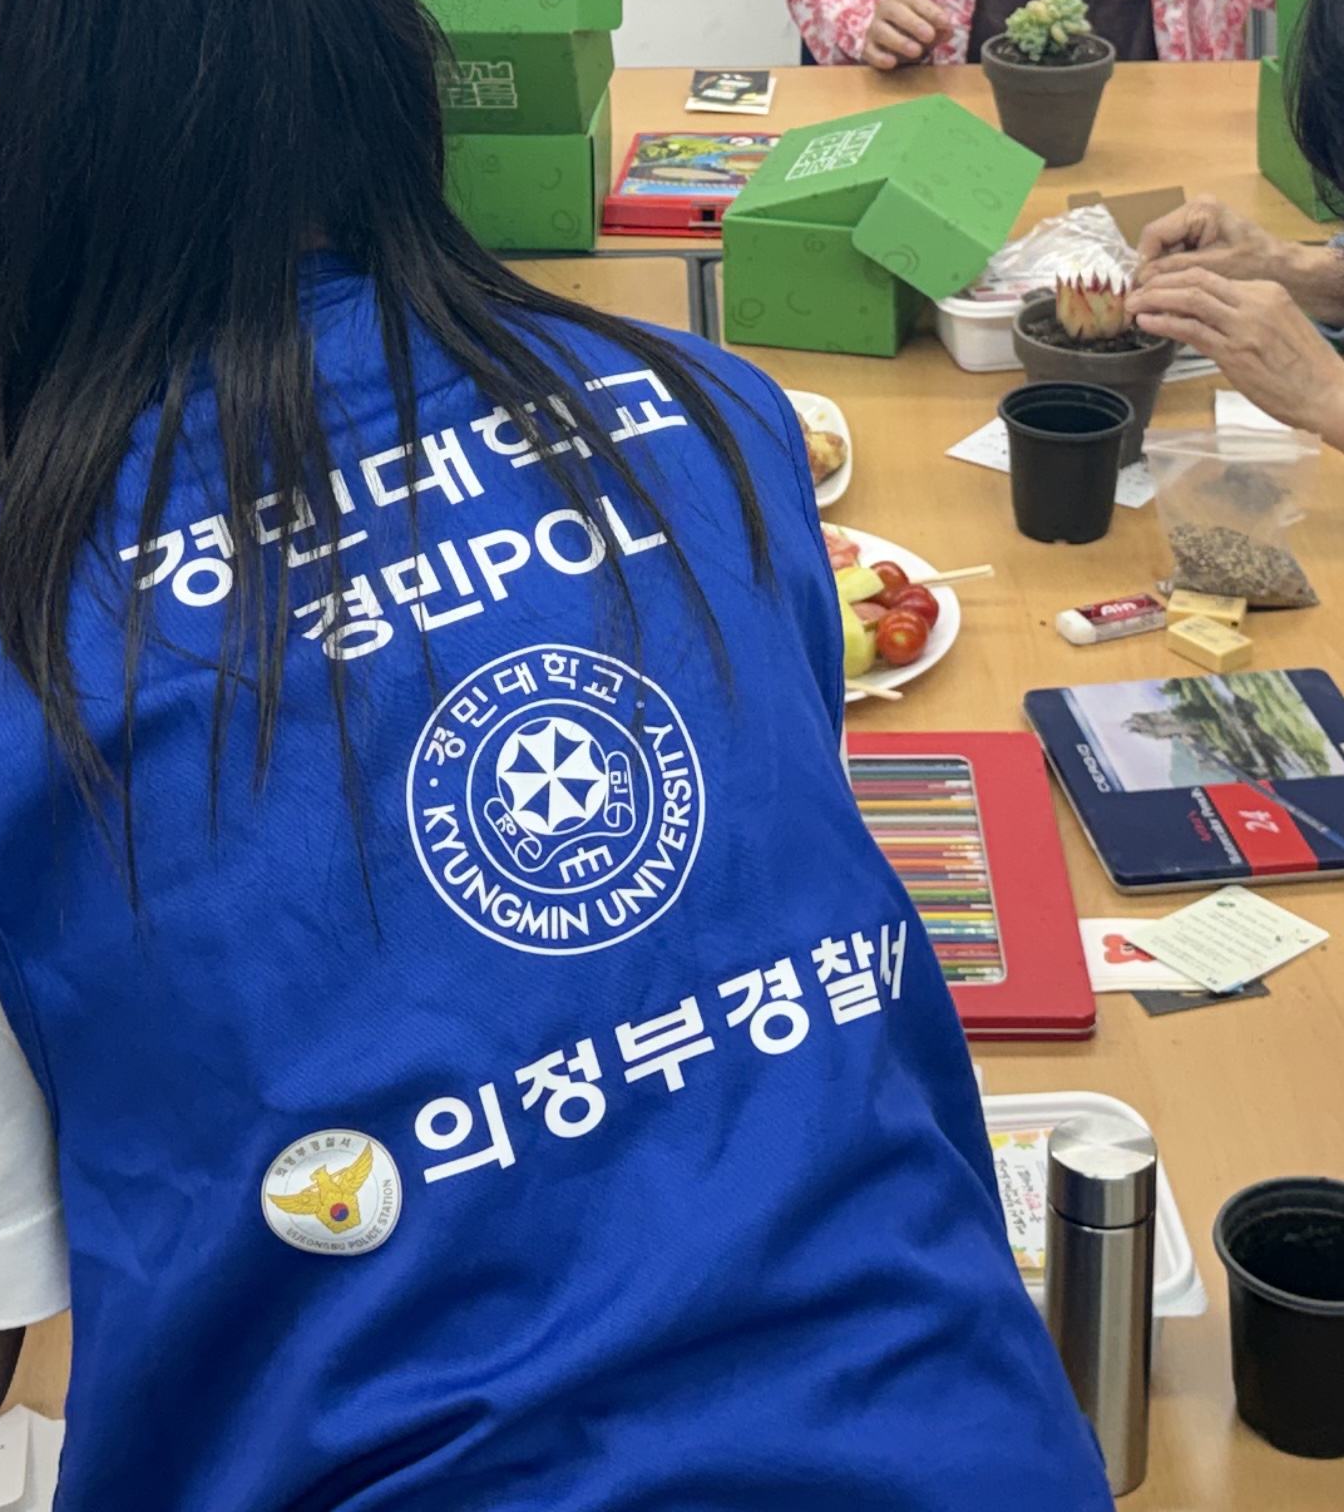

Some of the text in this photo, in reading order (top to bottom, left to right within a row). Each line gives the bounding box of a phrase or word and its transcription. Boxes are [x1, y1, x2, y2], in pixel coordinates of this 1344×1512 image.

[120, 369, 687, 607] 경민대학교
[294, 497, 670, 661] 경민POL
[423, 653, 625, 766] 경민대학교
[423, 723, 692, 940] KYUNGMIN UNIVERSITY
[1238, 810, 1280, 833] 24
[415, 921, 908, 1185] 의정부경찰서
[349, 1225, 383, 1249] POLICE
[377, 1179, 394, 1226] STATION
